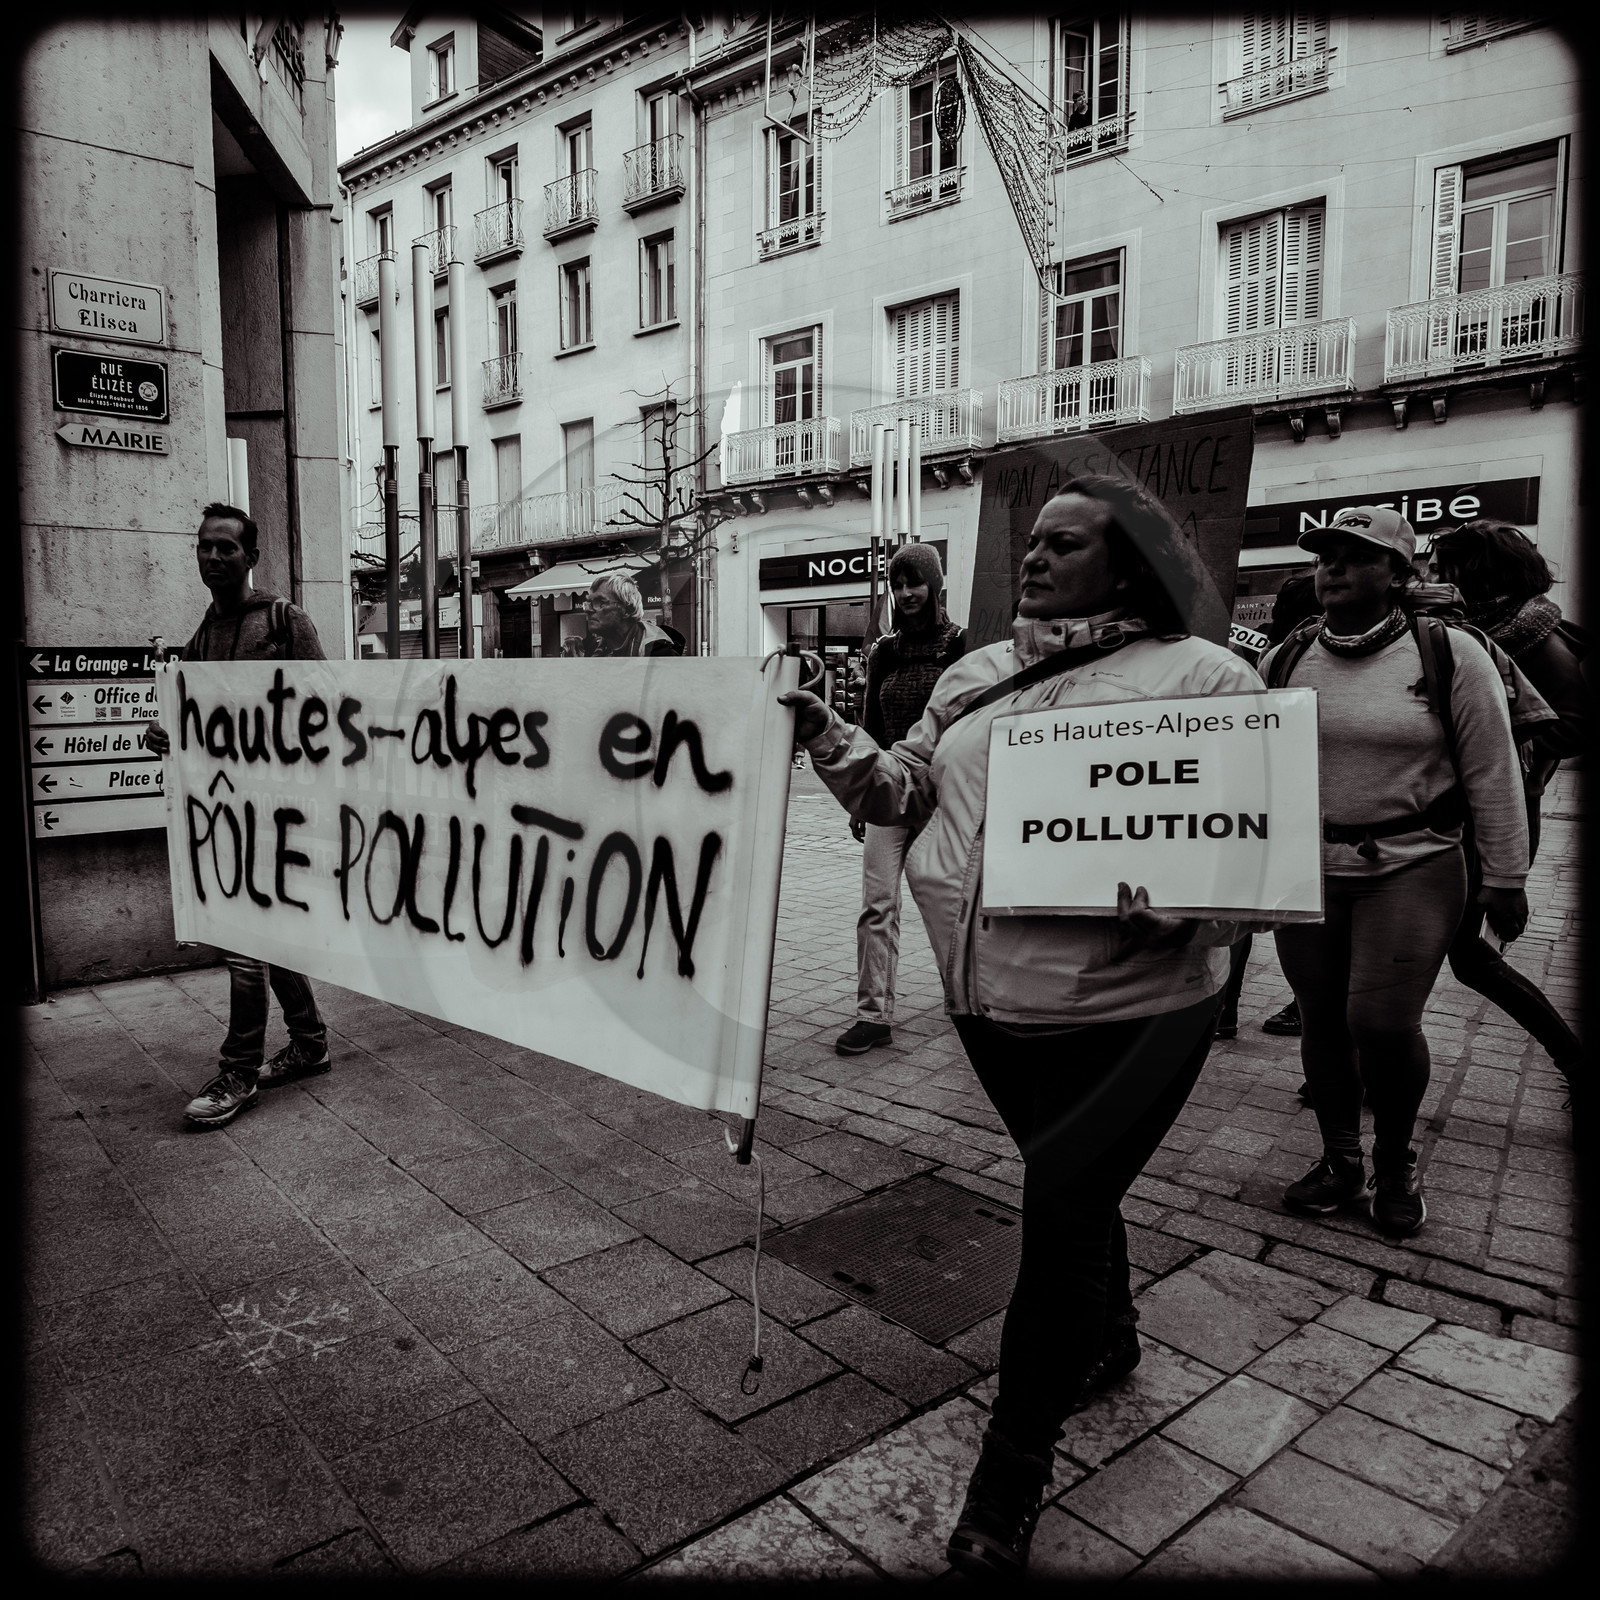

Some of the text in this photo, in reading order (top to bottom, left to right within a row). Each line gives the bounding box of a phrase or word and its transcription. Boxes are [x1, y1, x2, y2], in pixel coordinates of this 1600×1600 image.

[69, 282, 147, 311] Charriera
[78, 308, 138, 333] Elisea
[100, 362, 124, 377] RUE
[91, 375, 134, 394] ÉLIZÉE
[77, 397, 95, 405] Maire
[81, 427, 164, 451] MAIRIE
[992, 463, 1037, 509] NON
[1238, 609, 1267, 622] with
[1229, 626, 1269, 649] SOLD
[54, 655, 71, 672] La
[75, 655, 128, 675] Grange
[94, 686, 158, 705] Office d
[131, 706, 159, 718] Place
[176, 668, 550, 798] hautes-alpes
[599, 709, 734, 794] en
[1007, 712, 1281, 747] Les Hautes-Alpes en
[64, 734, 108, 754] Hôtel
[112, 734, 131, 751] de
[109, 770, 150, 788] Place
[1089, 759, 1200, 788] POLE
[1021, 812, 1269, 844] POLLUTION
[185, 770, 310, 912] PÔLE
